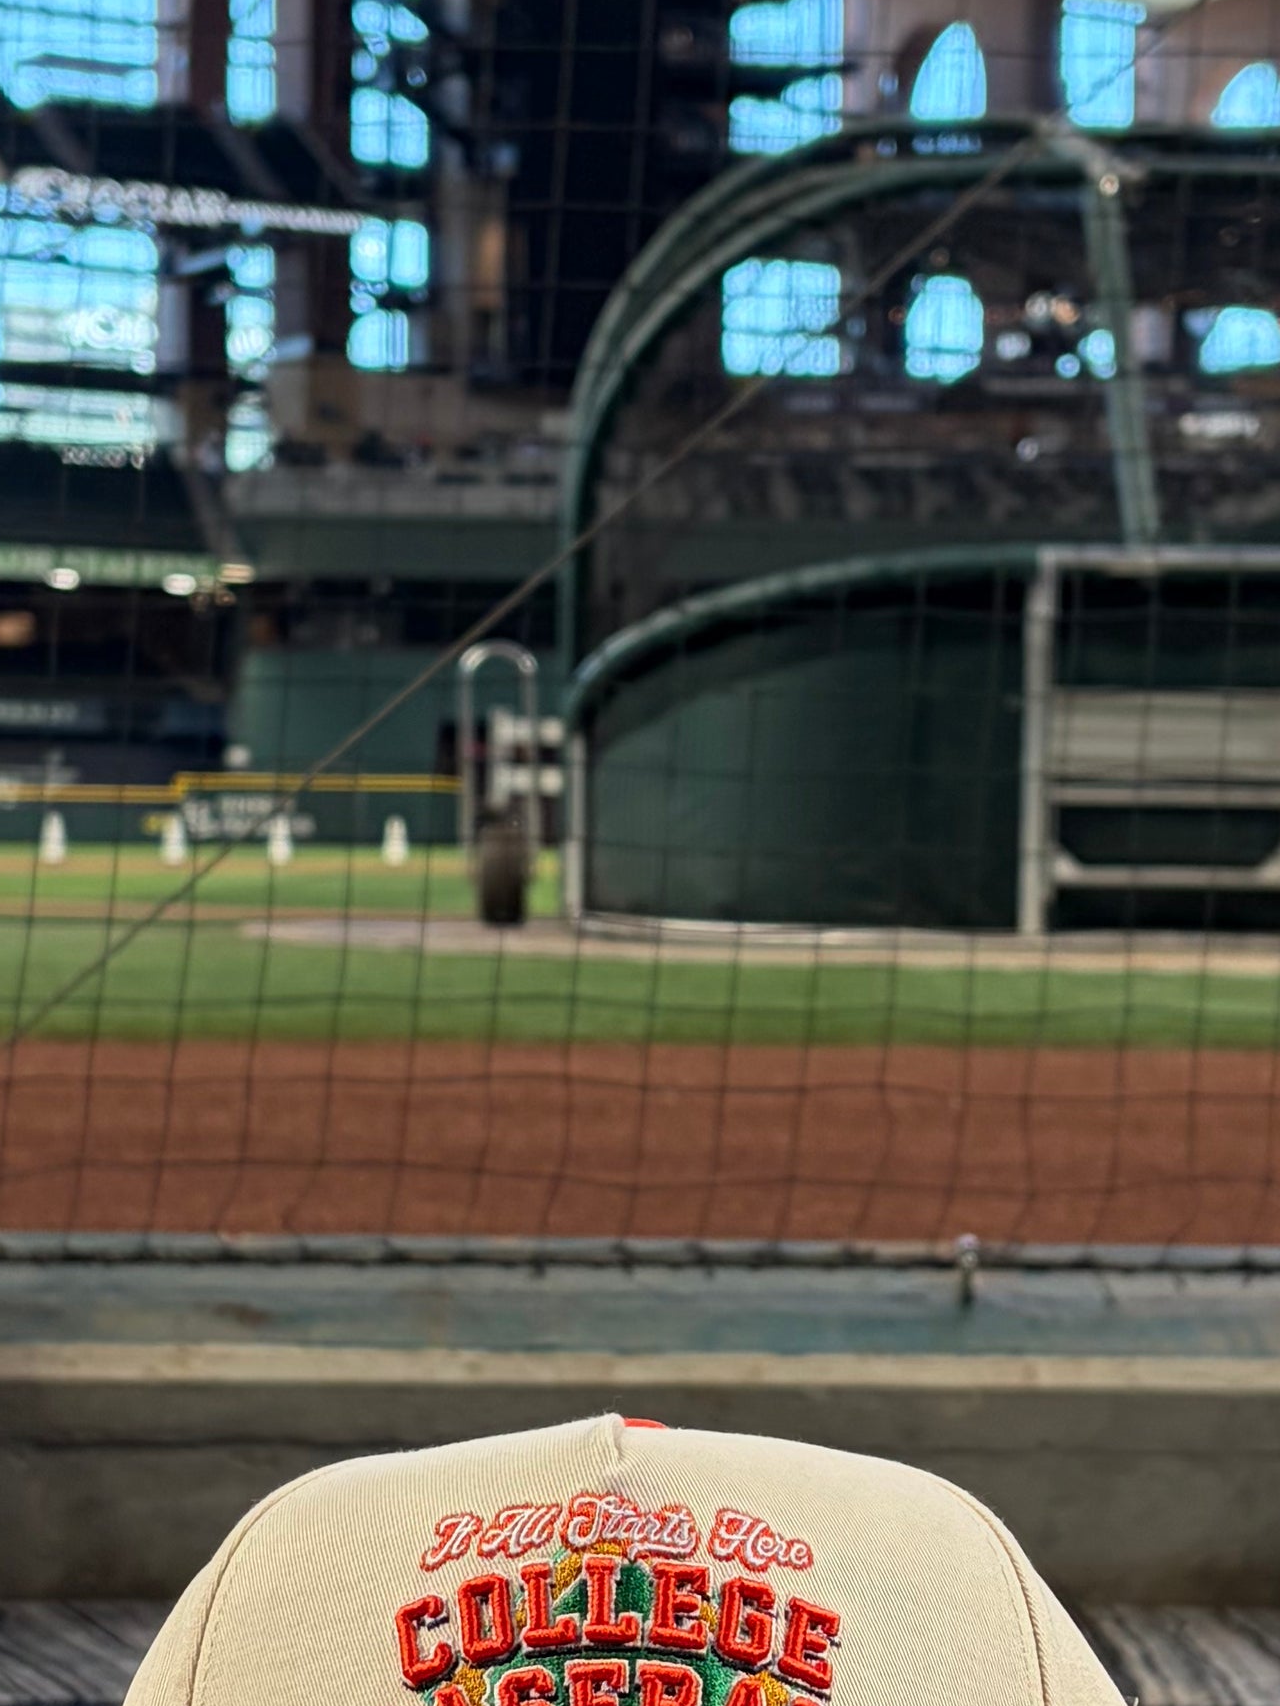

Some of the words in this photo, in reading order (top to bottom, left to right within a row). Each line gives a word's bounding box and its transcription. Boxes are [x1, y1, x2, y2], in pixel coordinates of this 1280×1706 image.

[476, 1502, 566, 1557] All
[560, 1492, 701, 1562] Starts
[709, 1506, 814, 1572] Here
[394, 1554, 843, 1693] COLLEGE
